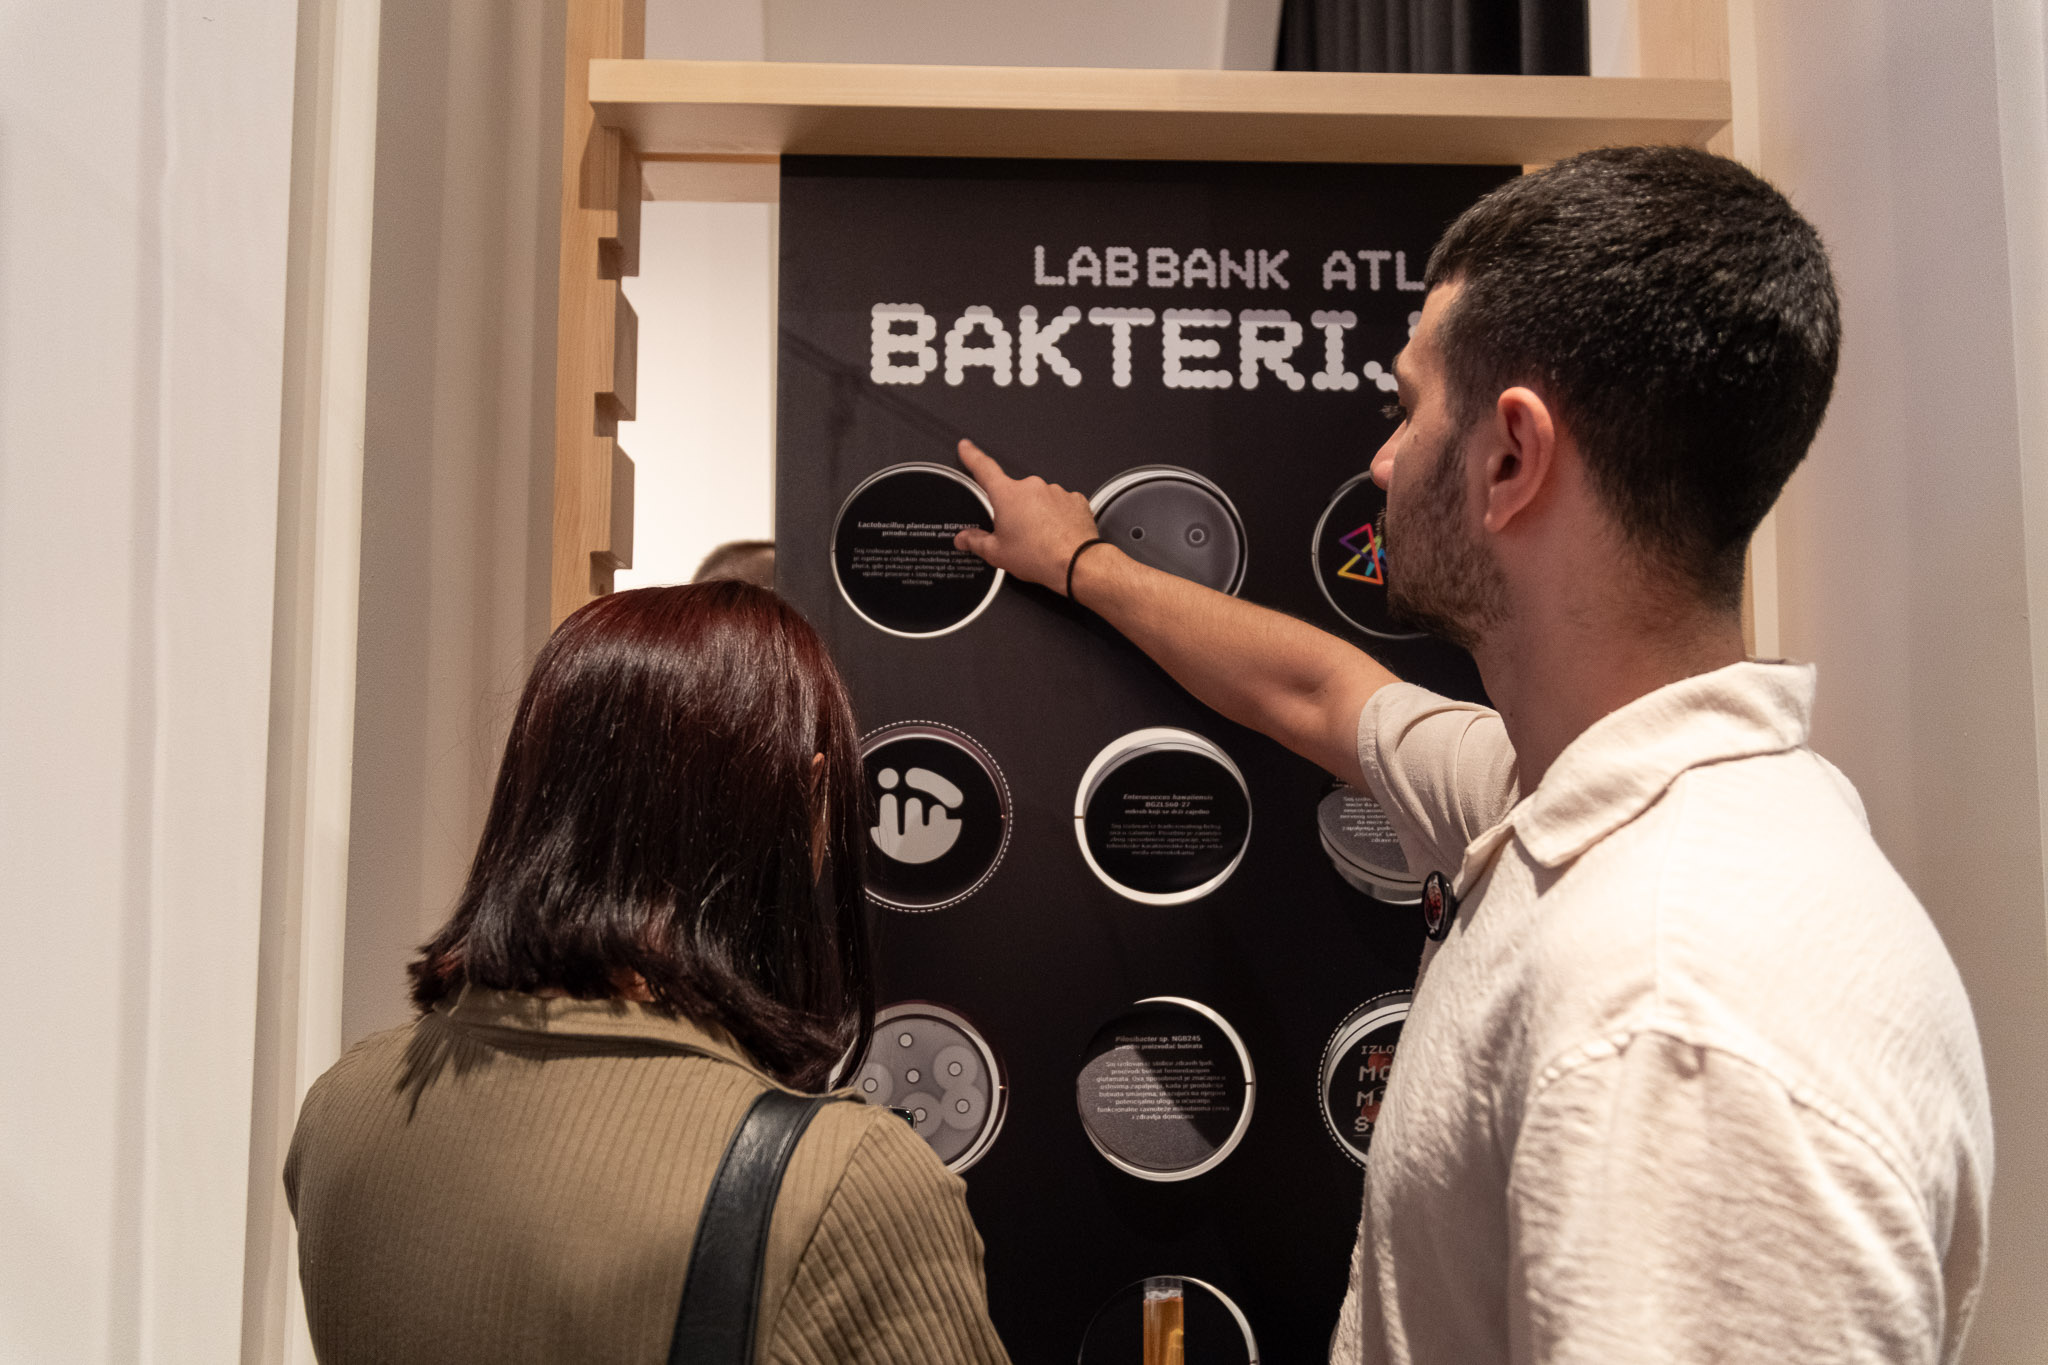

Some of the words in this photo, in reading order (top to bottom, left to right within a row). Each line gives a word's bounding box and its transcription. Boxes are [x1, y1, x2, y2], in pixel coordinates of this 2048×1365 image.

[1034, 245, 1290, 291] LABBANK
[857, 521, 905, 529] Lactobacillus
[906, 522, 942, 530] plantarum
